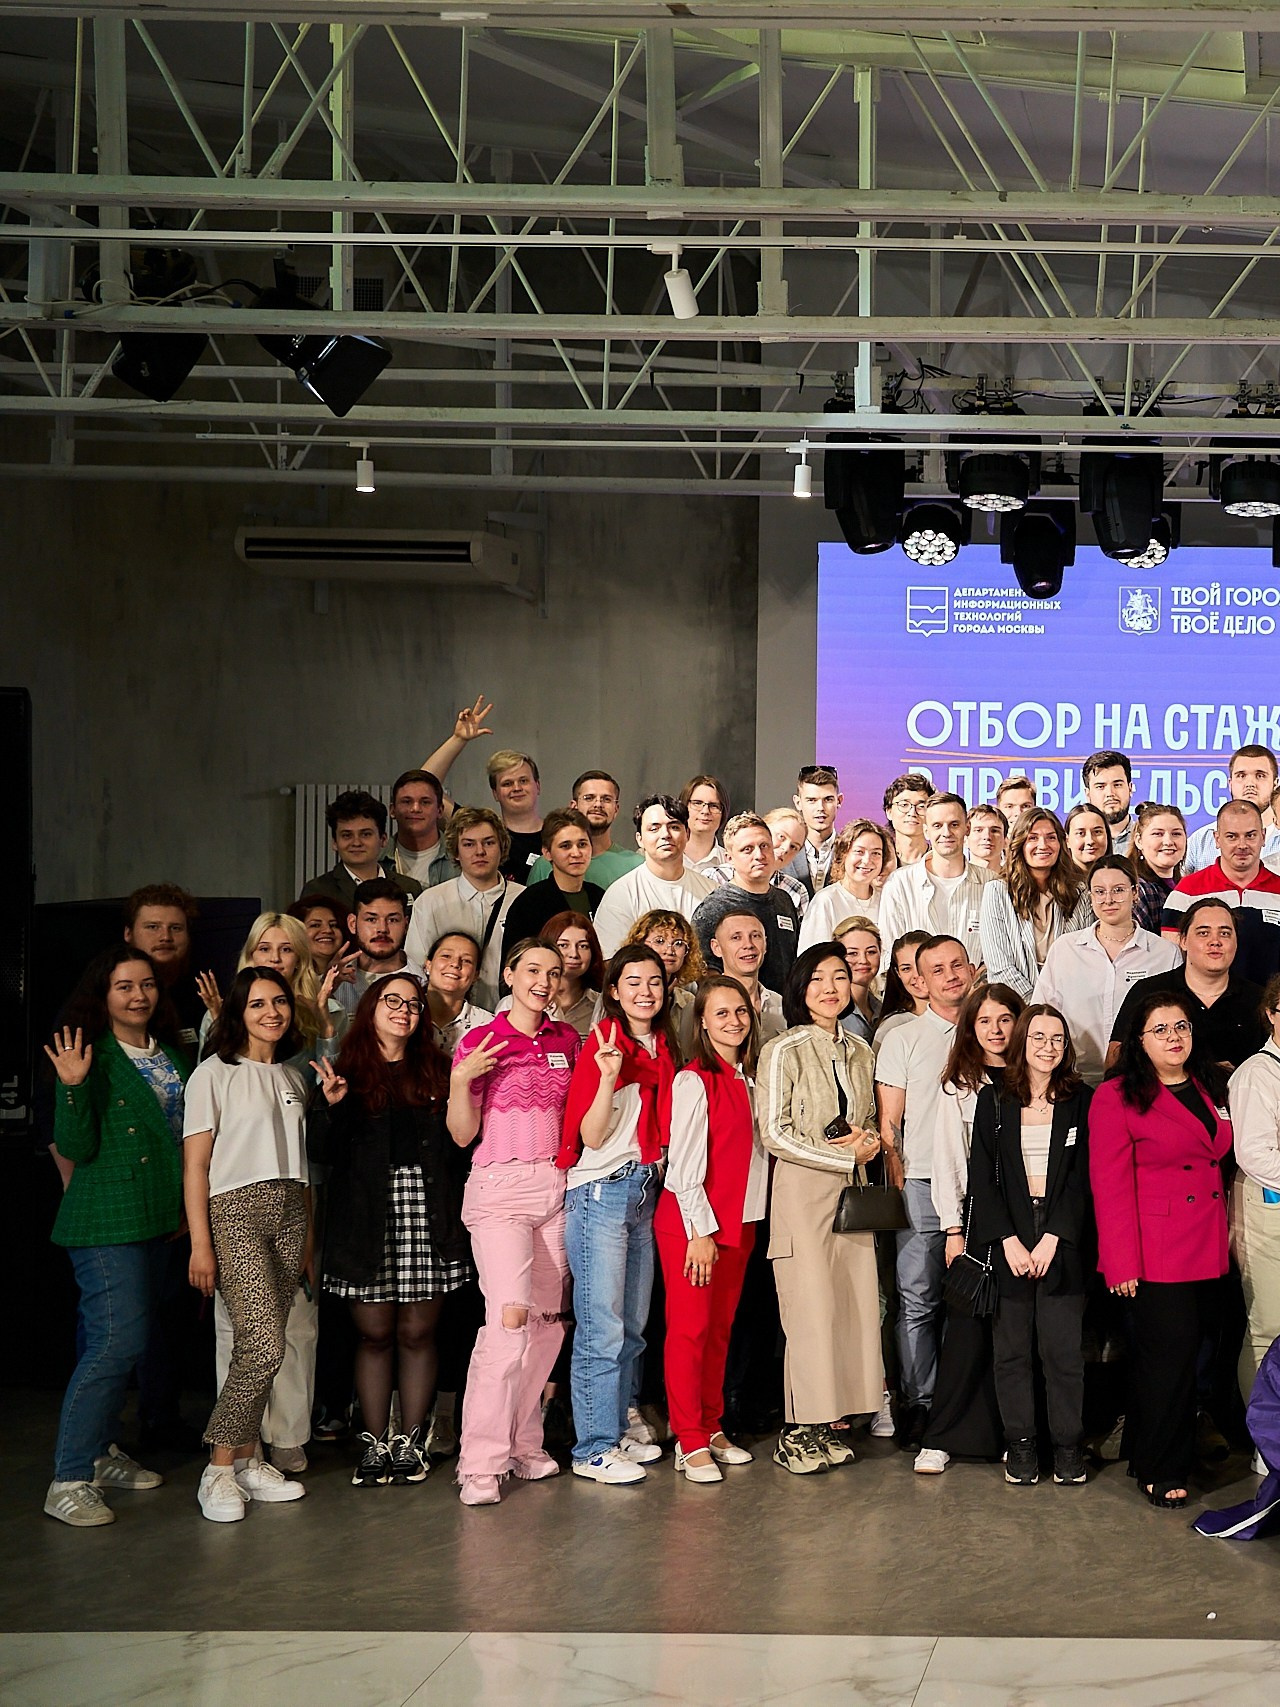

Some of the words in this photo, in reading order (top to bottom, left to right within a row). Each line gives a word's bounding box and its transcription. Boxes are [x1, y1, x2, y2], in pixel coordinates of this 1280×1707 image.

[1171, 582, 1220, 606] ТВОЙ
[953, 600, 1062, 610] ИНФОРМАЦИОННЫХ
[953, 611, 1022, 622] ТЕХНОЛОГИЙ
[1171, 611, 1220, 634] ТВОЁ
[1223, 615, 1276, 637] ДЕЛО
[953, 625, 996, 634] ГОРОДА
[997, 625, 1045, 634] МОСКВЫ
[906, 699, 1082, 749] ОТБОР
[1094, 702, 1152, 749] НА
